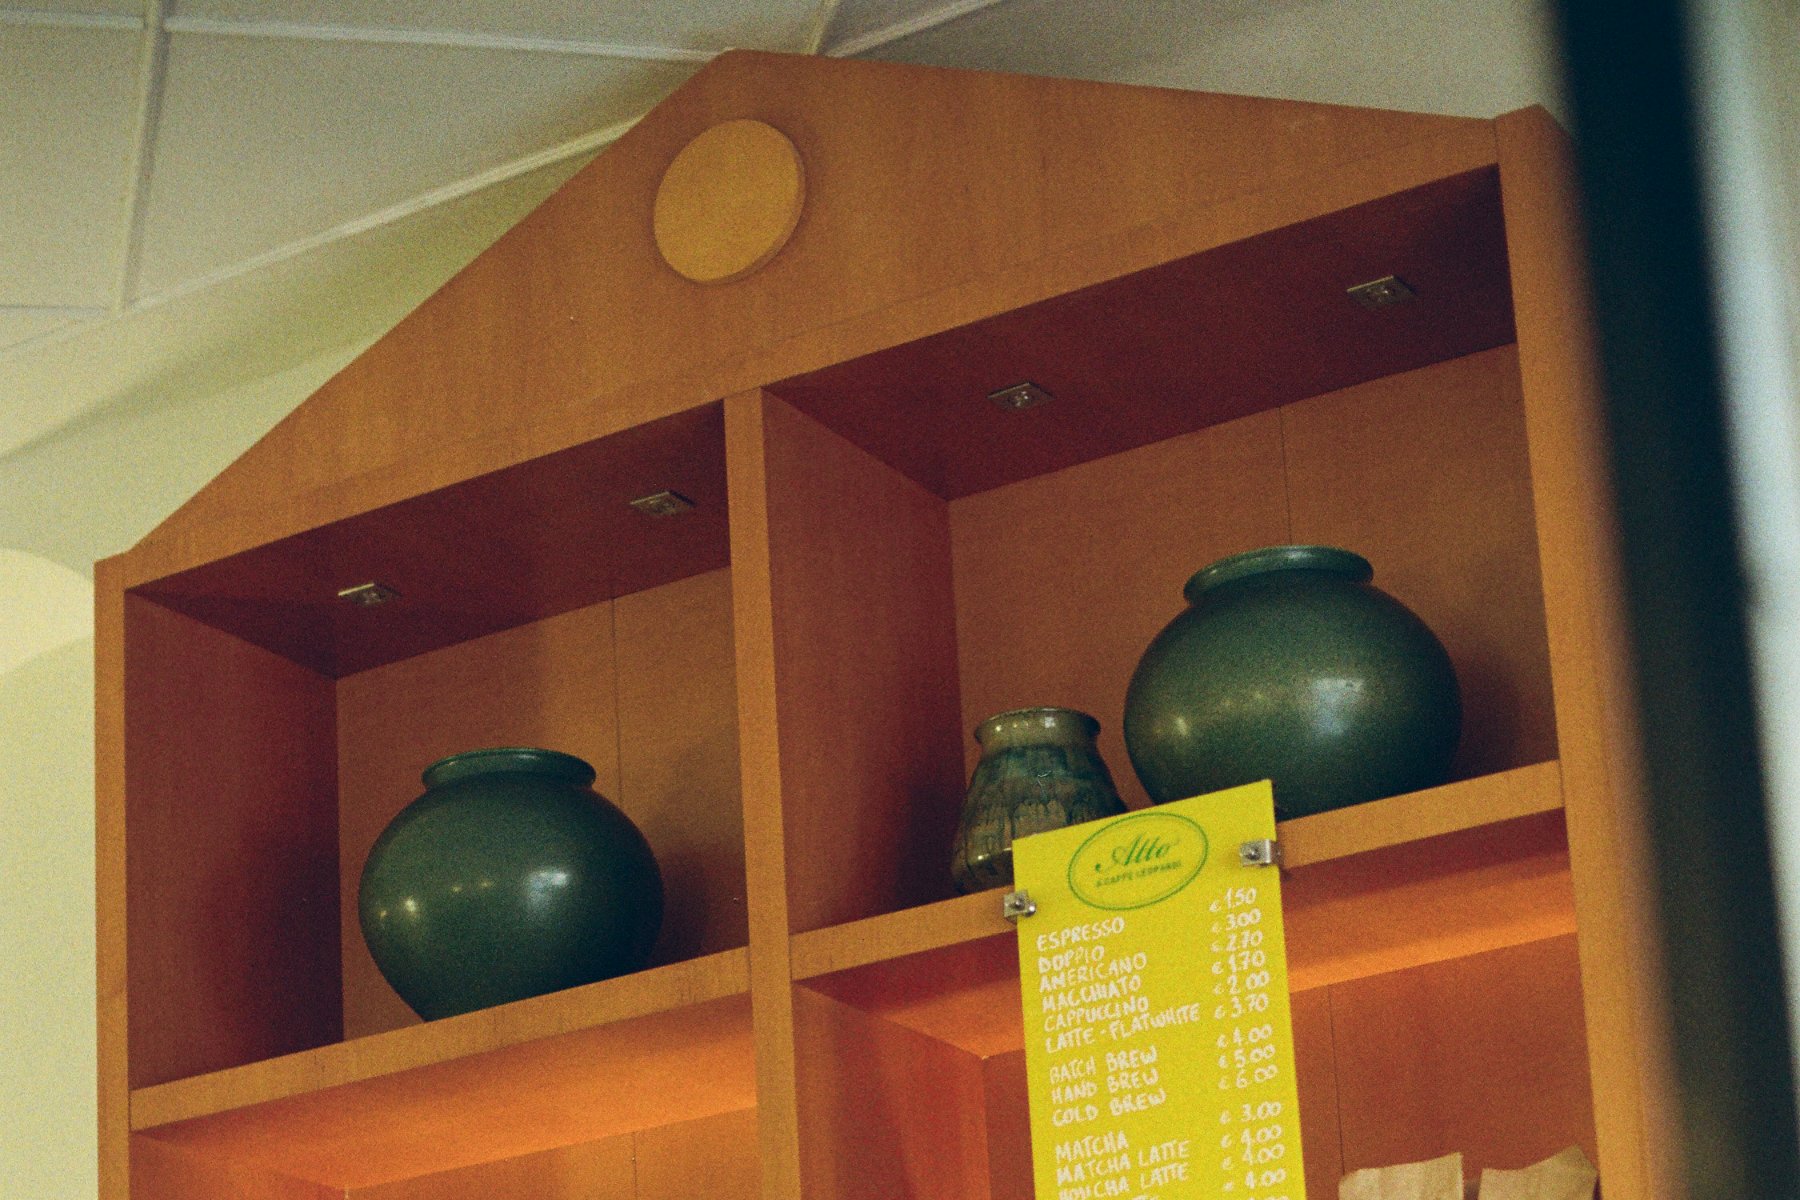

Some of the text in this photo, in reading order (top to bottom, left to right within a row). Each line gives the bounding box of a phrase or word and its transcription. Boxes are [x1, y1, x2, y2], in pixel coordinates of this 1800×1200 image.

[1036, 916, 1125, 951] ESPRESSO
[1038, 945, 1105, 974] DOPPIO
[1040, 952, 1147, 993] AMERICANO
[1042, 974, 1141, 1013] MACCHIATO
[1044, 996, 1149, 1032] CAPPUCCINO
[1045, 1027, 1096, 1053] LATTE
[1050, 1057, 1096, 1085] BATCH
[1106, 1045, 1158, 1072] BREW
[1051, 1082, 1098, 1105] HAND
[1107, 1068, 1160, 1094] BREW
[1052, 1104, 1098, 1127] COLD
[1109, 1088, 1166, 1117] BREW
[1055, 1130, 1129, 1164] MATCHA
[1057, 1153, 1131, 1186] MATCHA
[1138, 1140, 1190, 1167] LATTE
[1140, 1162, 1189, 1190] LATTE
